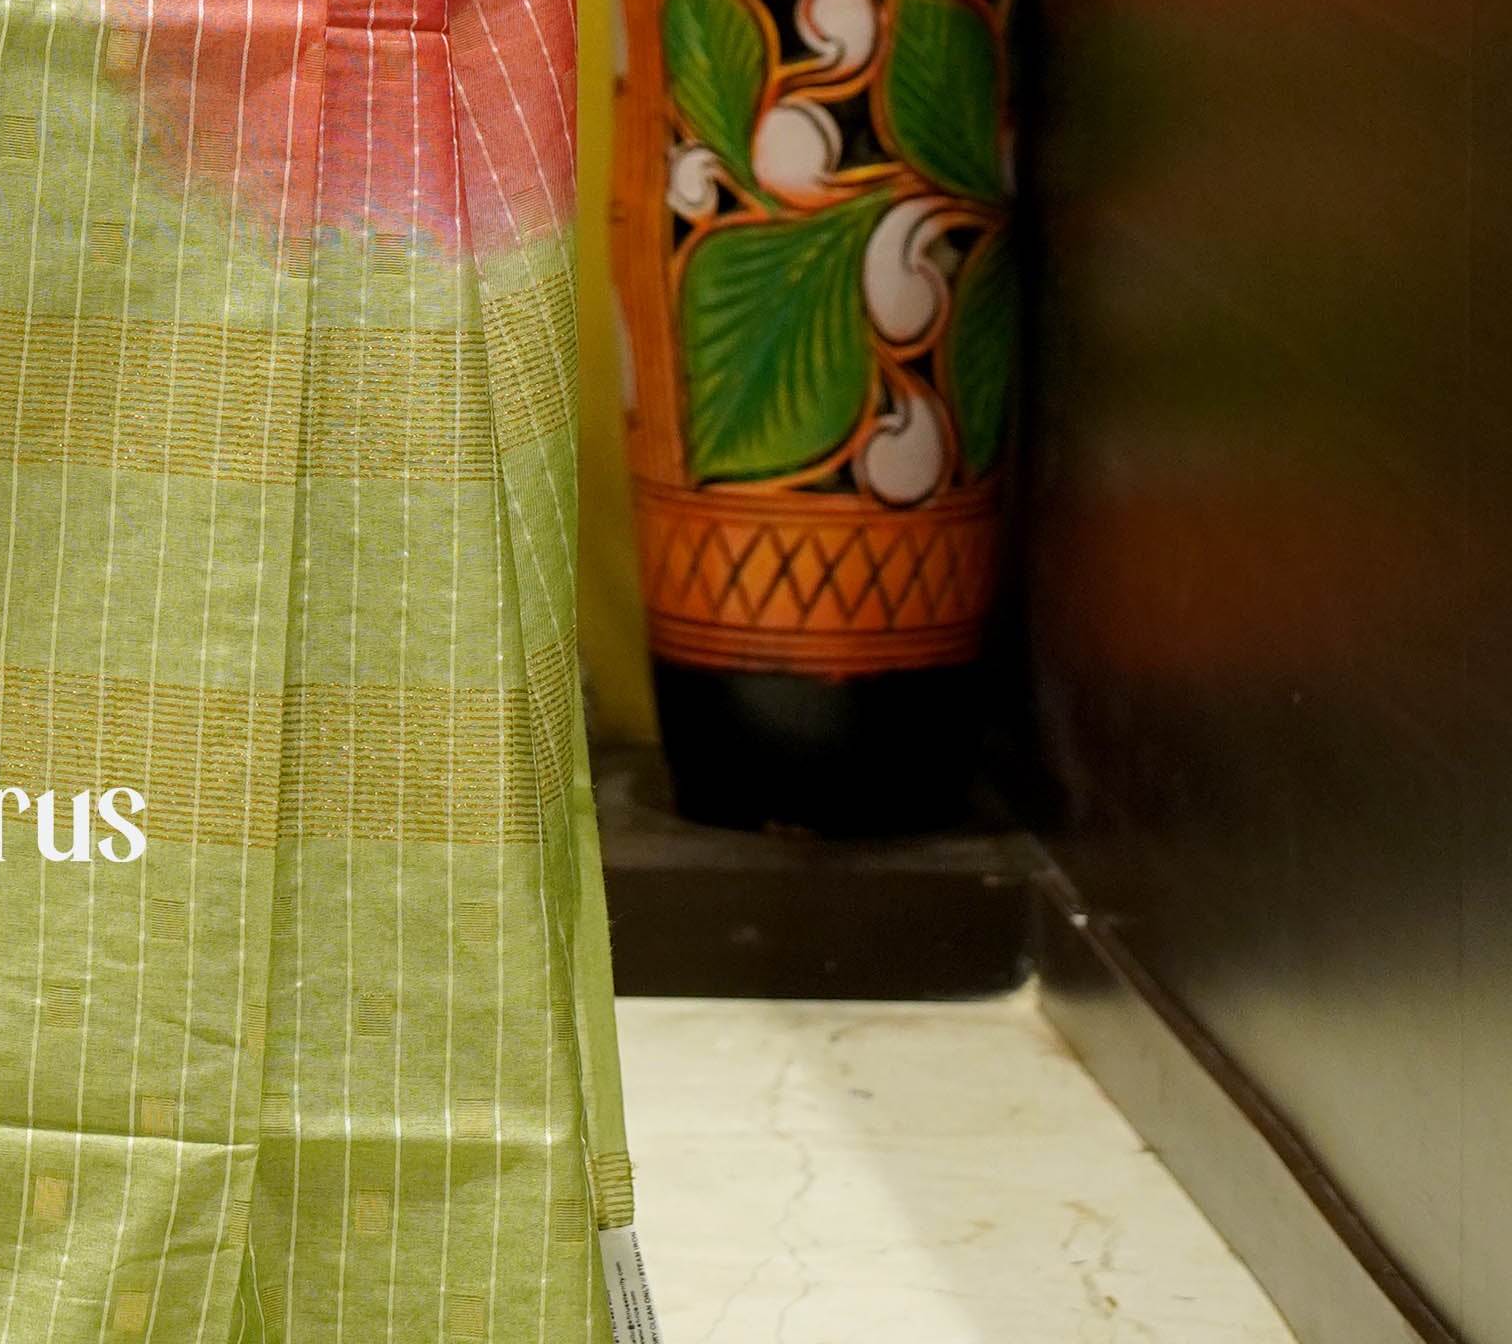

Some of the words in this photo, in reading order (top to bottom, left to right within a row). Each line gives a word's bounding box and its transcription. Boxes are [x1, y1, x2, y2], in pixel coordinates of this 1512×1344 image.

[631, 1231, 639, 1250] IRON
[635, 1251, 645, 1276] STEAM
[641, 1283, 651, 1304] ONLY
[646, 1305, 656, 1330] CLEAN
